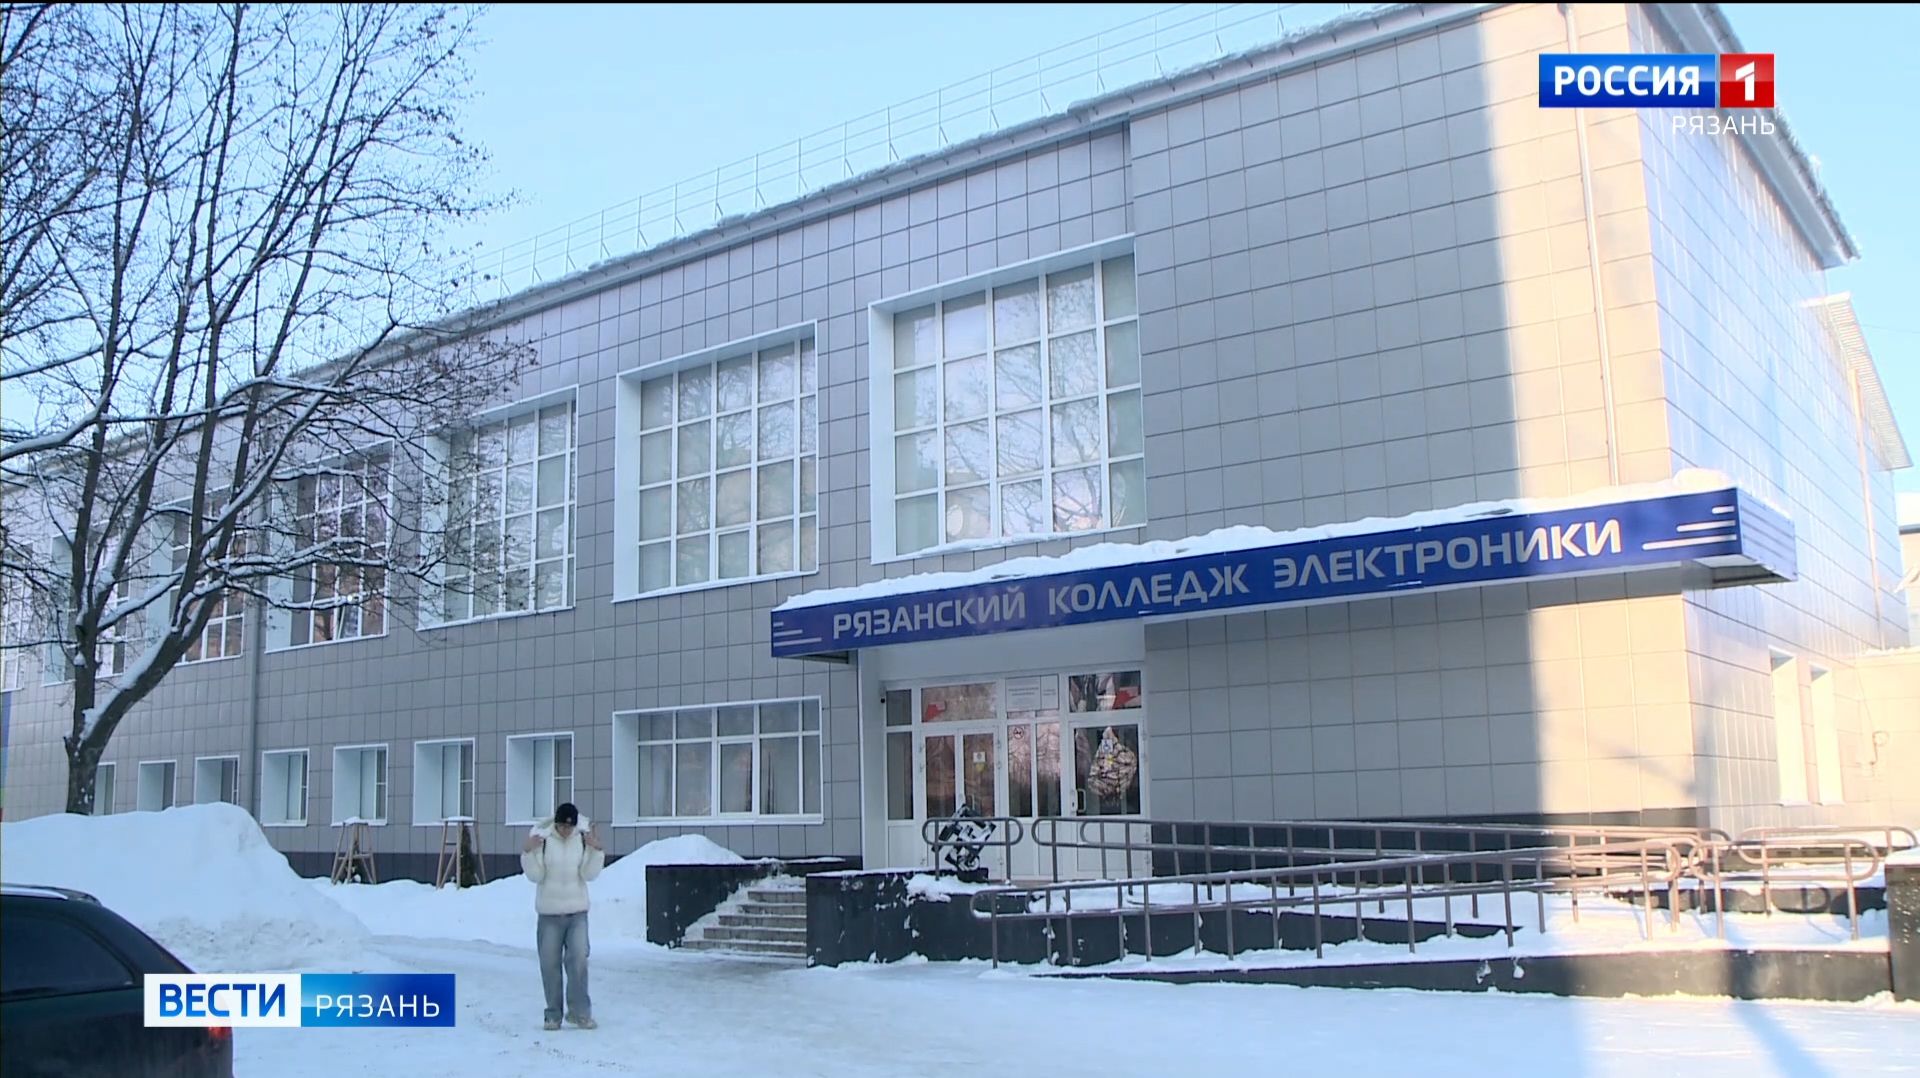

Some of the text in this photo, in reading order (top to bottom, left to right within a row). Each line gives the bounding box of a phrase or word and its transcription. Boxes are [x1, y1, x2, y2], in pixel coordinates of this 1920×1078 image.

[832, 518, 1623, 640] РЯЗАНСКИЙ КОЛЛЕДЖ ЭЛЕКТРОНИКИ
